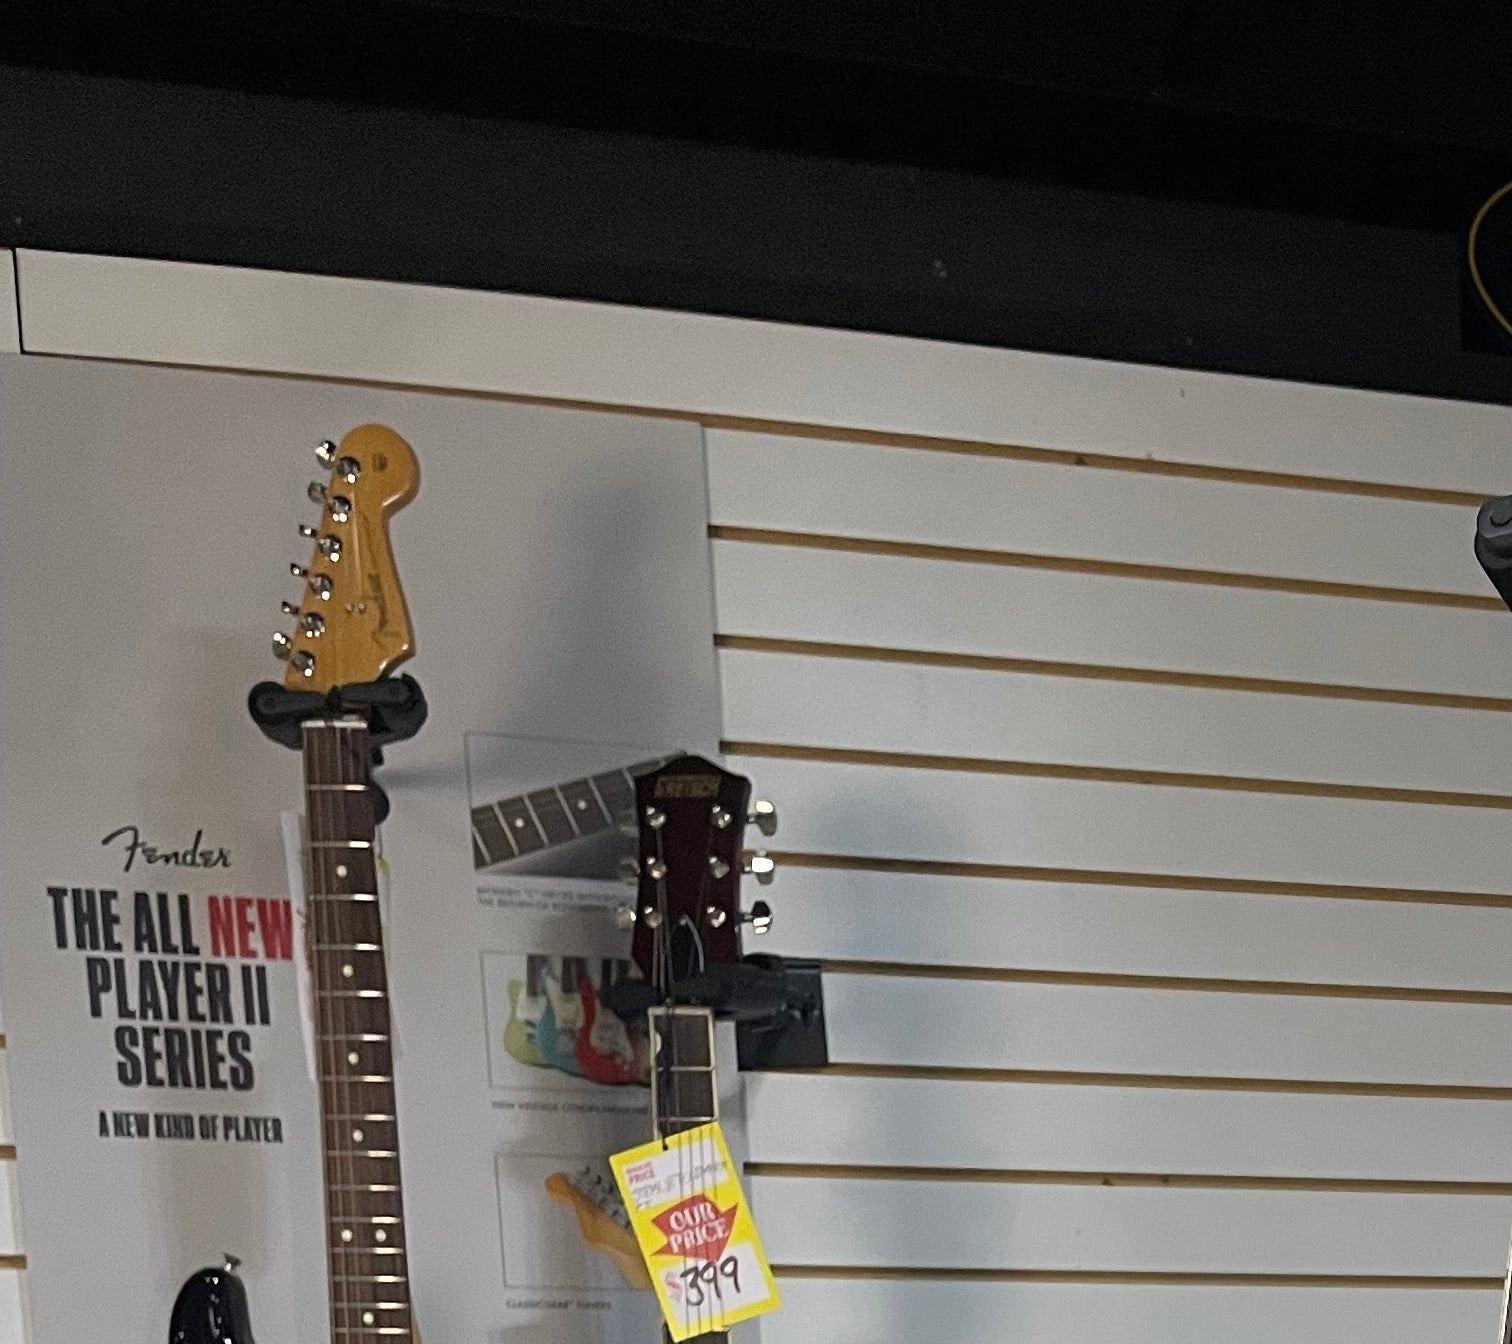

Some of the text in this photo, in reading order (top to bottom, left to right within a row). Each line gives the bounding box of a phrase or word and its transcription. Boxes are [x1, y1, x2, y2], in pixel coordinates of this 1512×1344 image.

[102, 825, 232, 873] Fender
[47, 886, 293, 961] THE ALL NEW
[87, 957, 271, 1026] PLAYER II
[114, 1025, 255, 1092] SERIES
[99, 1110, 283, 1144] A NEW KIND OF PLAYER
[669, 1201, 717, 1232] OUR
[669, 1217, 730, 1254] PRICE
